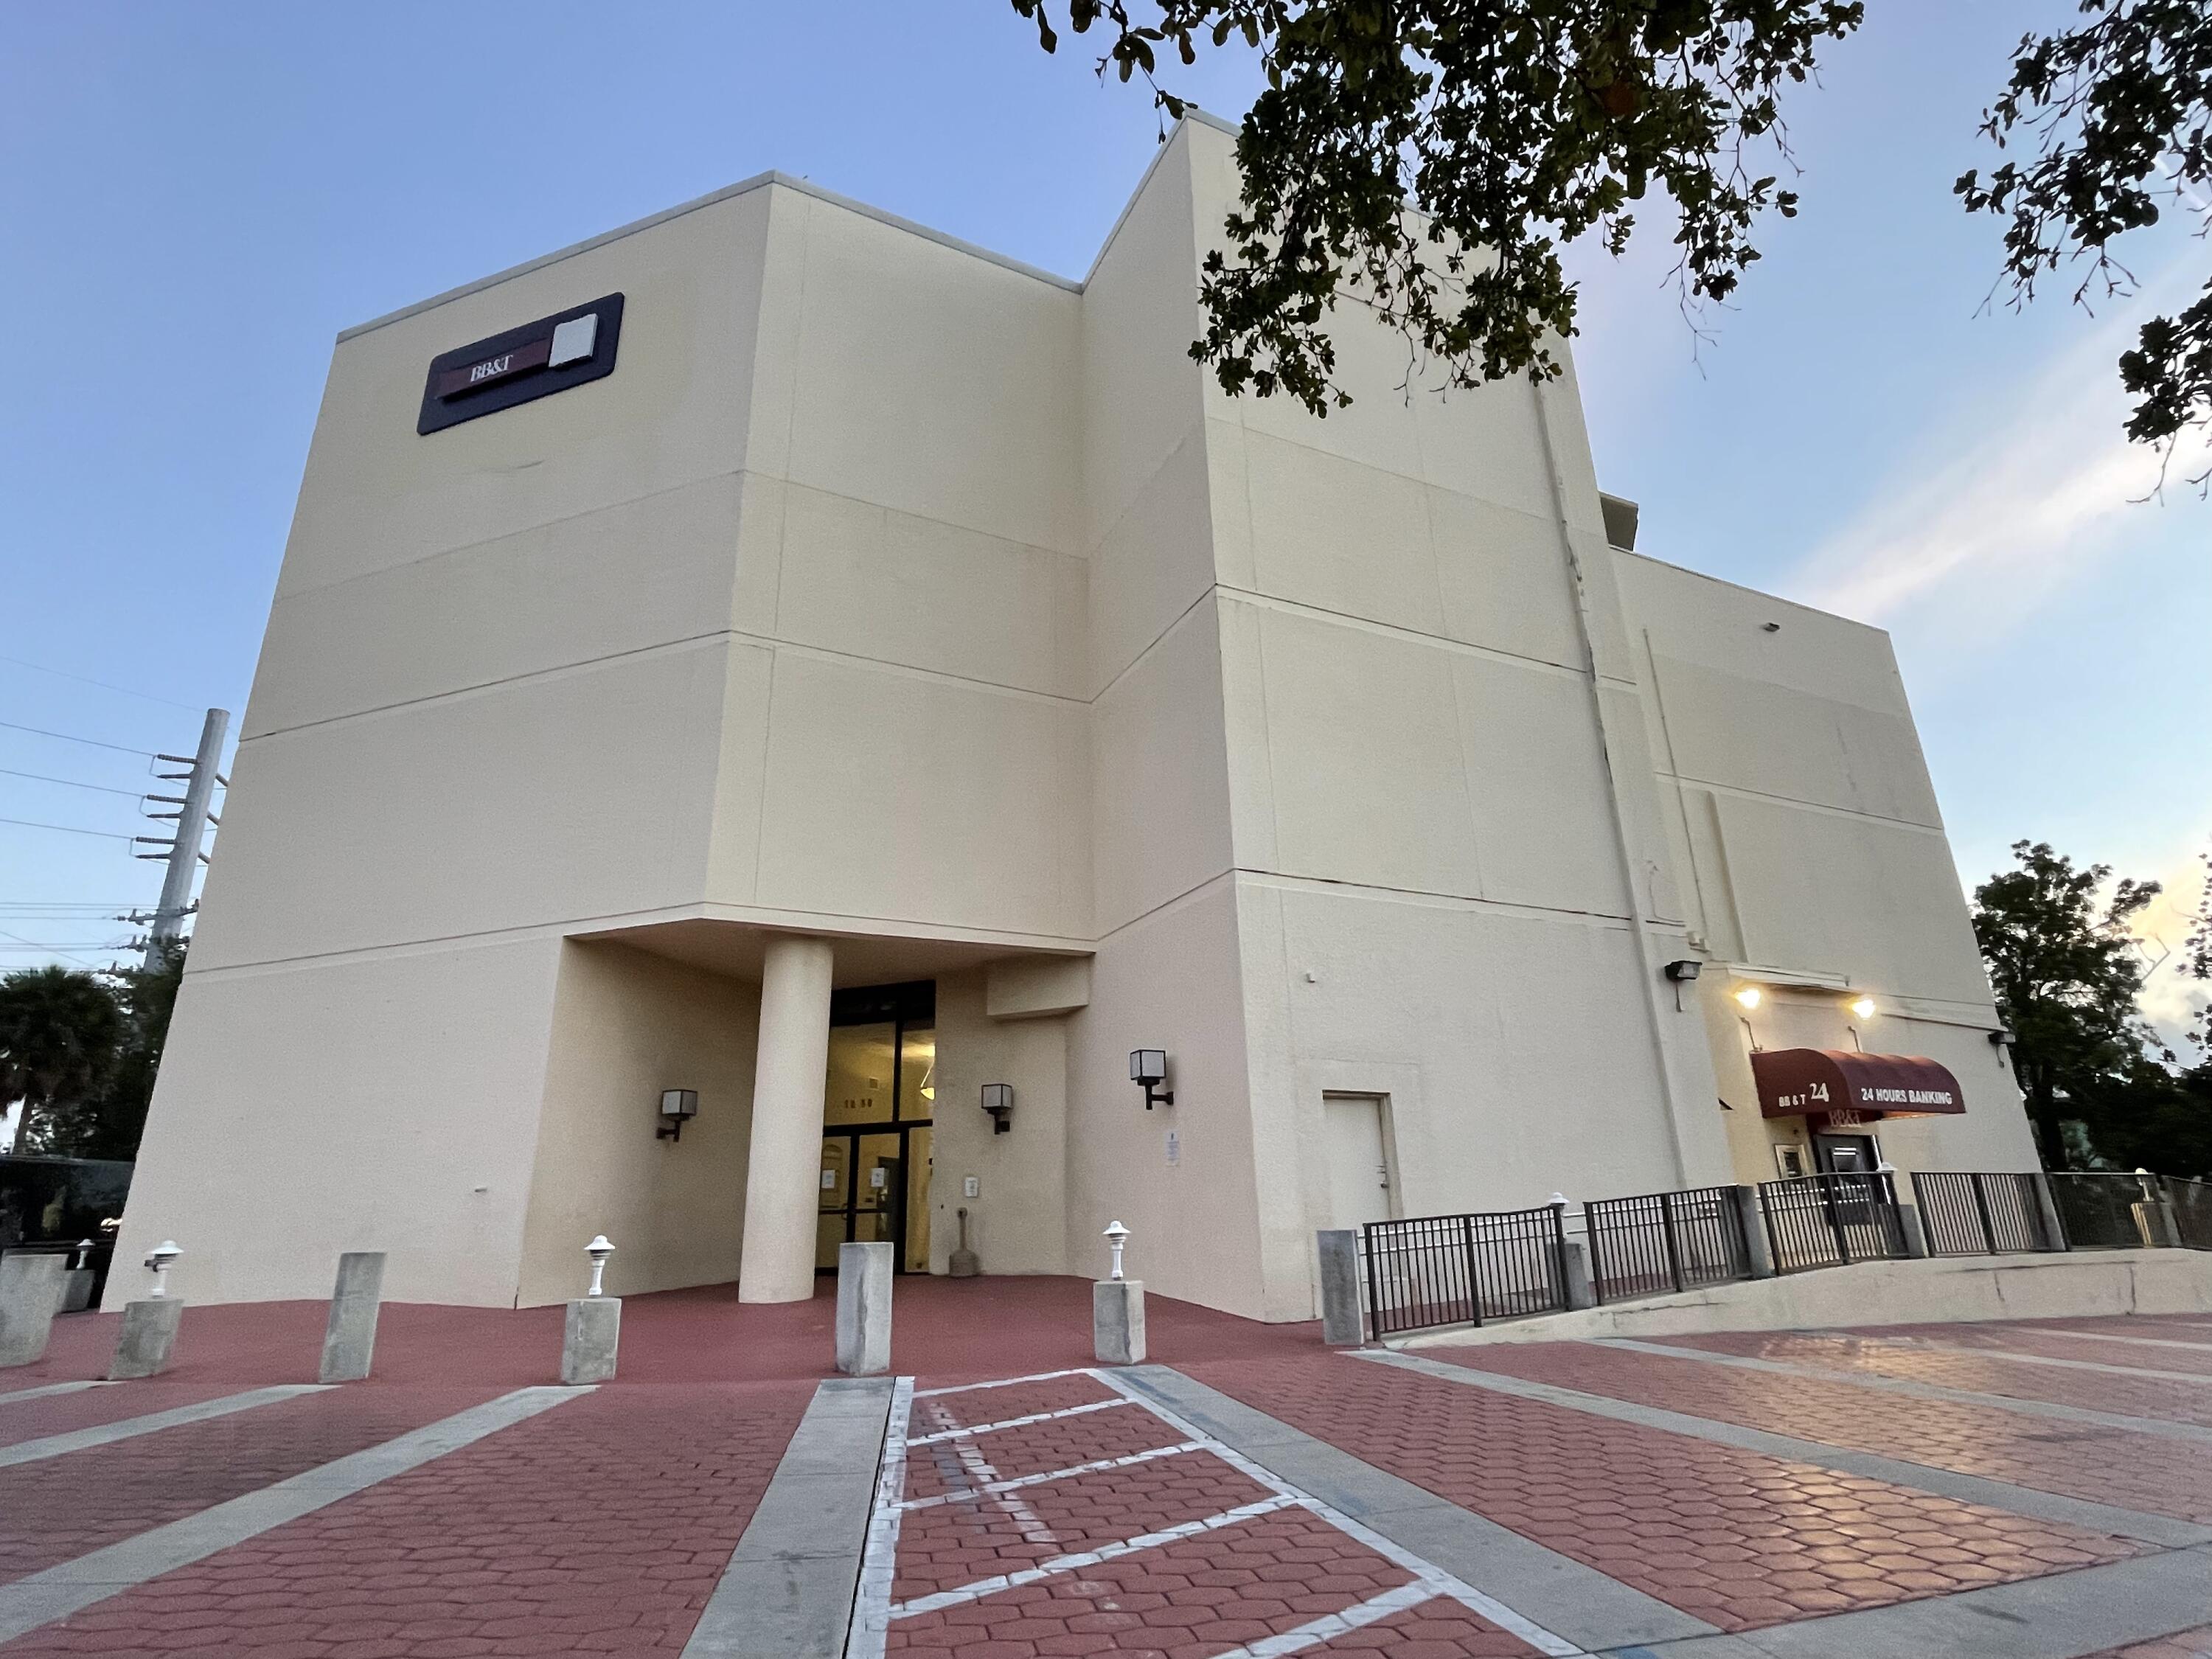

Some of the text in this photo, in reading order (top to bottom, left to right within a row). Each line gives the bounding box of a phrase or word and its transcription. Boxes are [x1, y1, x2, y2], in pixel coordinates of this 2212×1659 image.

[470, 354, 513, 382] BB&T
[1800, 1093, 1806, 1105] T
[1809, 1082, 1829, 1102] 24
[1861, 1088, 1952, 1105] 24 HOURS BANKING
[1828, 1109, 1863, 1127] BB&T
